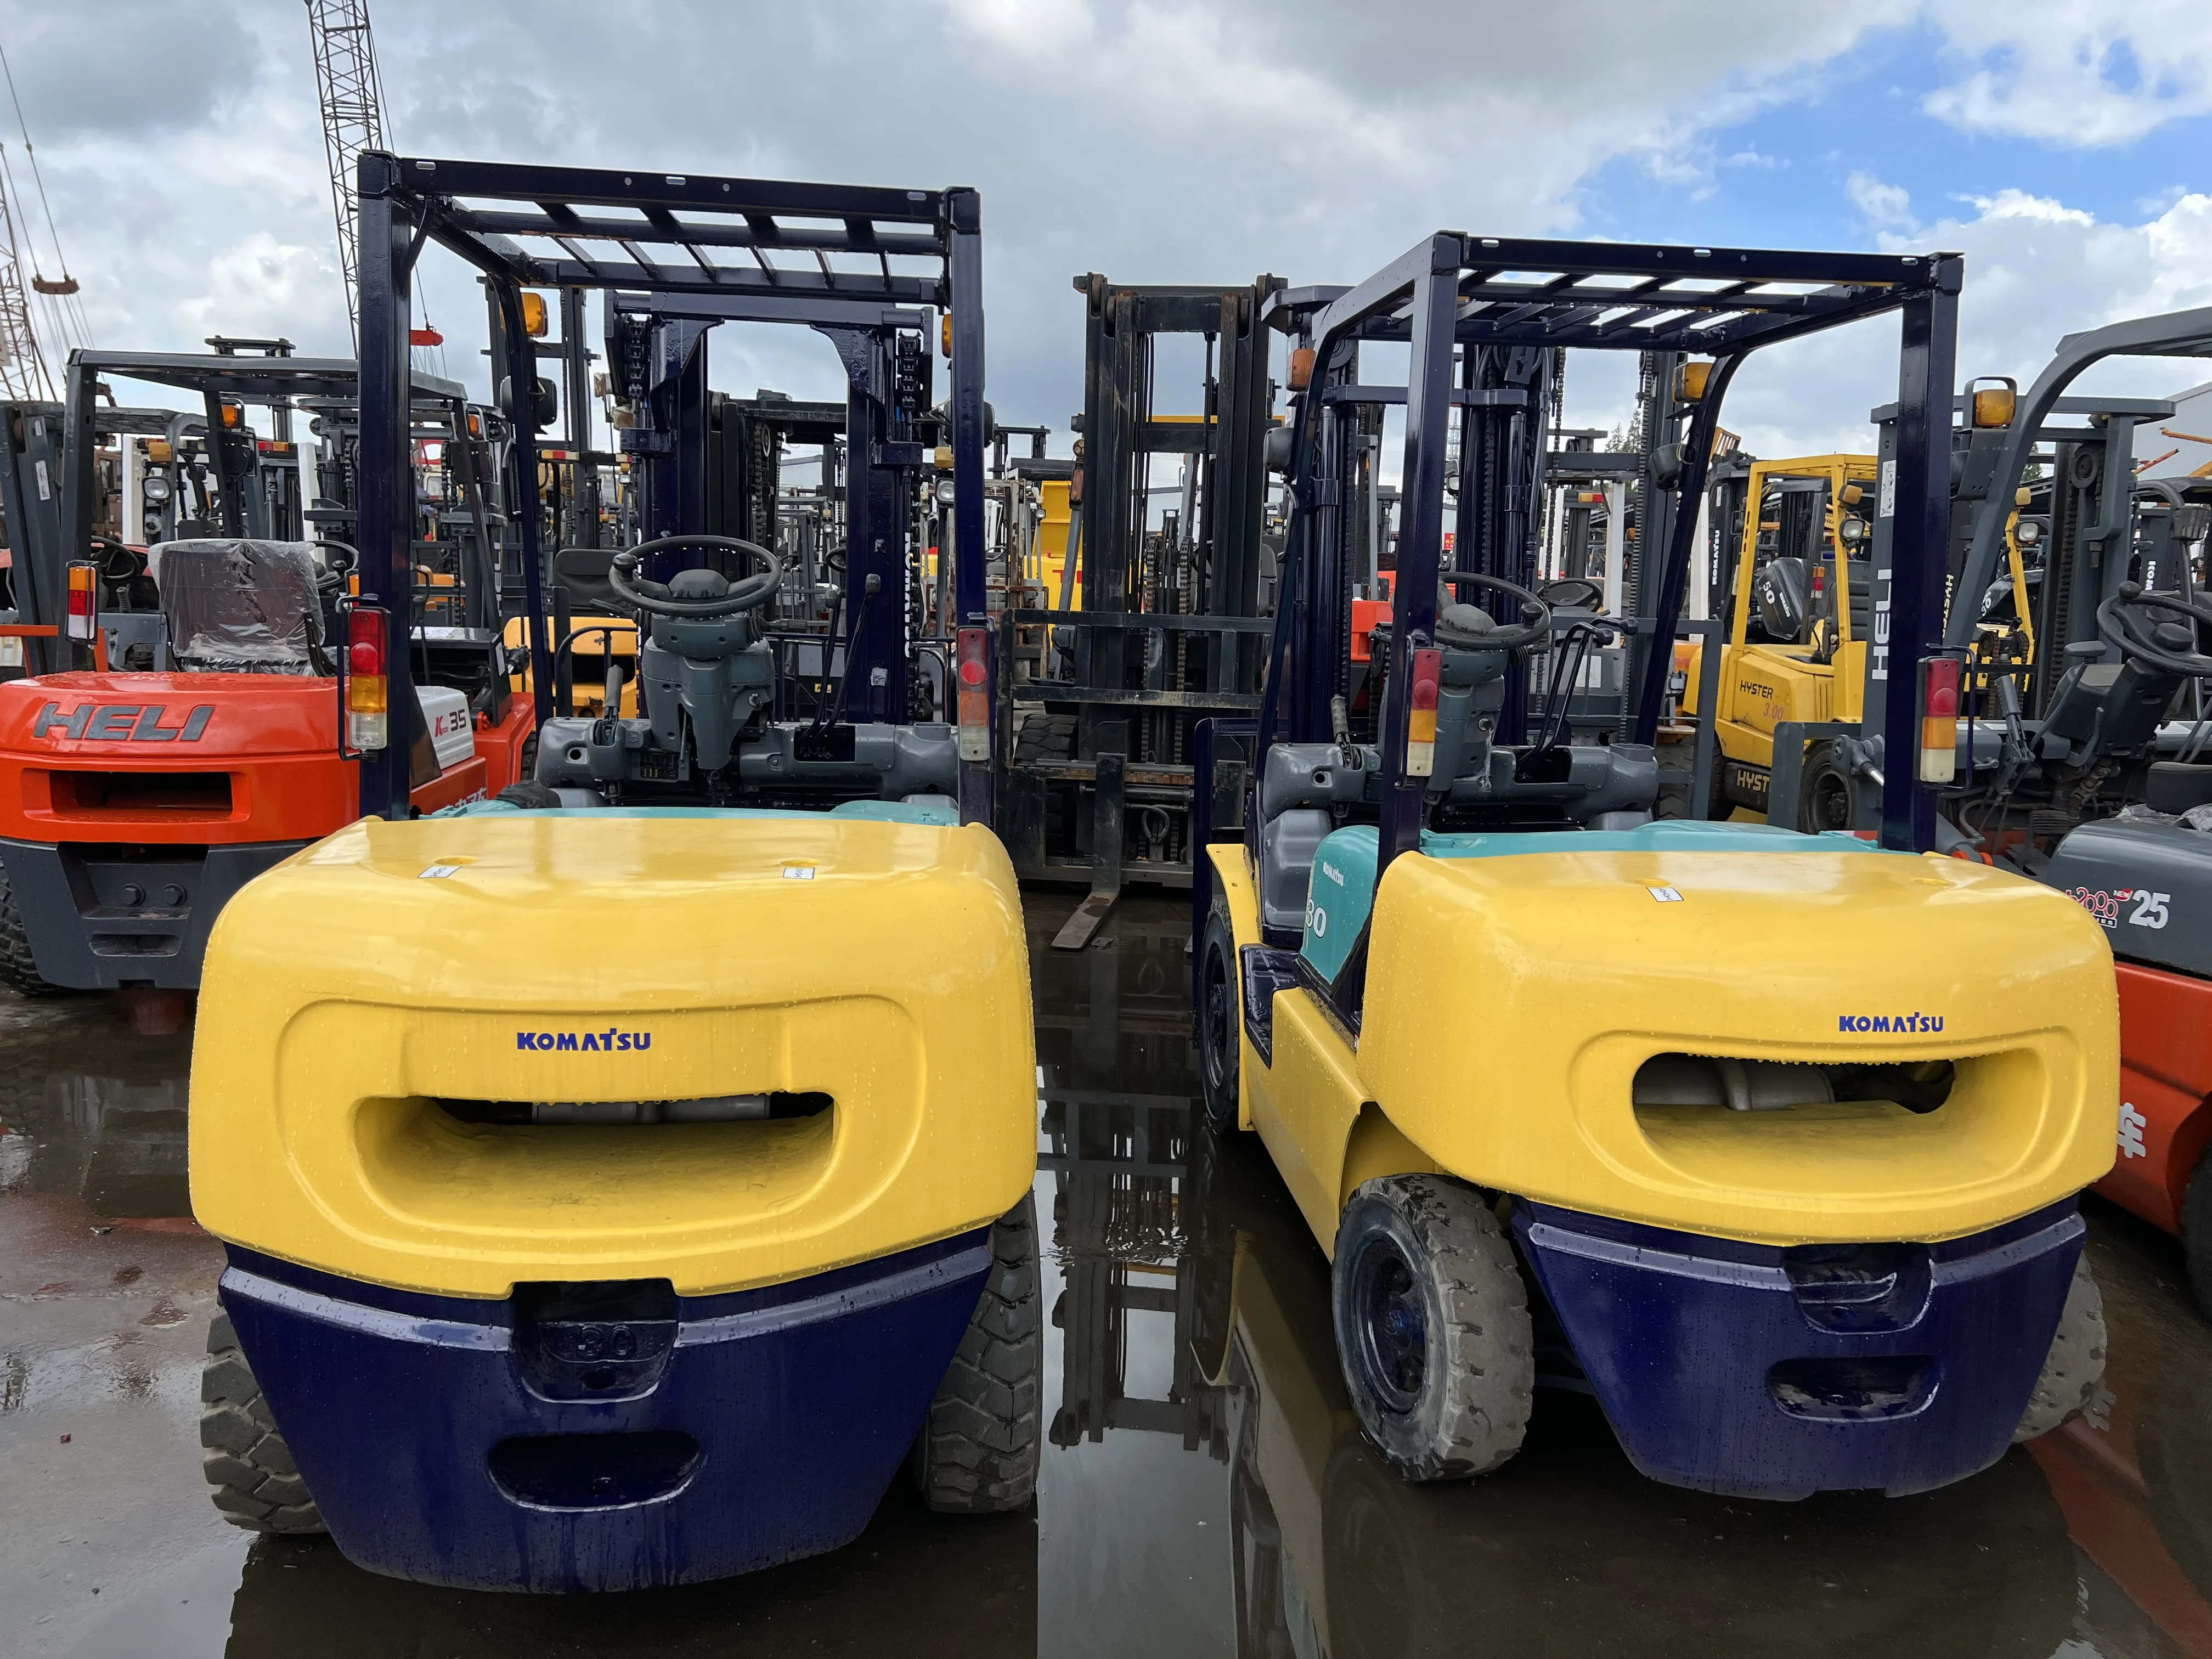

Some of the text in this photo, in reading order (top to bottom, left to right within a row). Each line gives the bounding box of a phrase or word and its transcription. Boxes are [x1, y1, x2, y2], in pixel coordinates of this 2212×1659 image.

[1763, 581, 1775, 604] 50
[1872, 569, 1892, 680] HELI
[1740, 680, 1773, 699] HYSTER
[33, 702, 216, 741] HELI
[449, 709, 466, 731] 35
[1764, 702, 1784, 720] 3.00
[1323, 861, 1344, 887] KOMATSU
[2113, 889, 2131, 898] NEW
[1305, 897, 1327, 939] 30
[2129, 889, 2171, 929] 25
[1839, 1012, 1944, 1032] KOMATSU
[517, 1028, 651, 1052] KOMATSU
